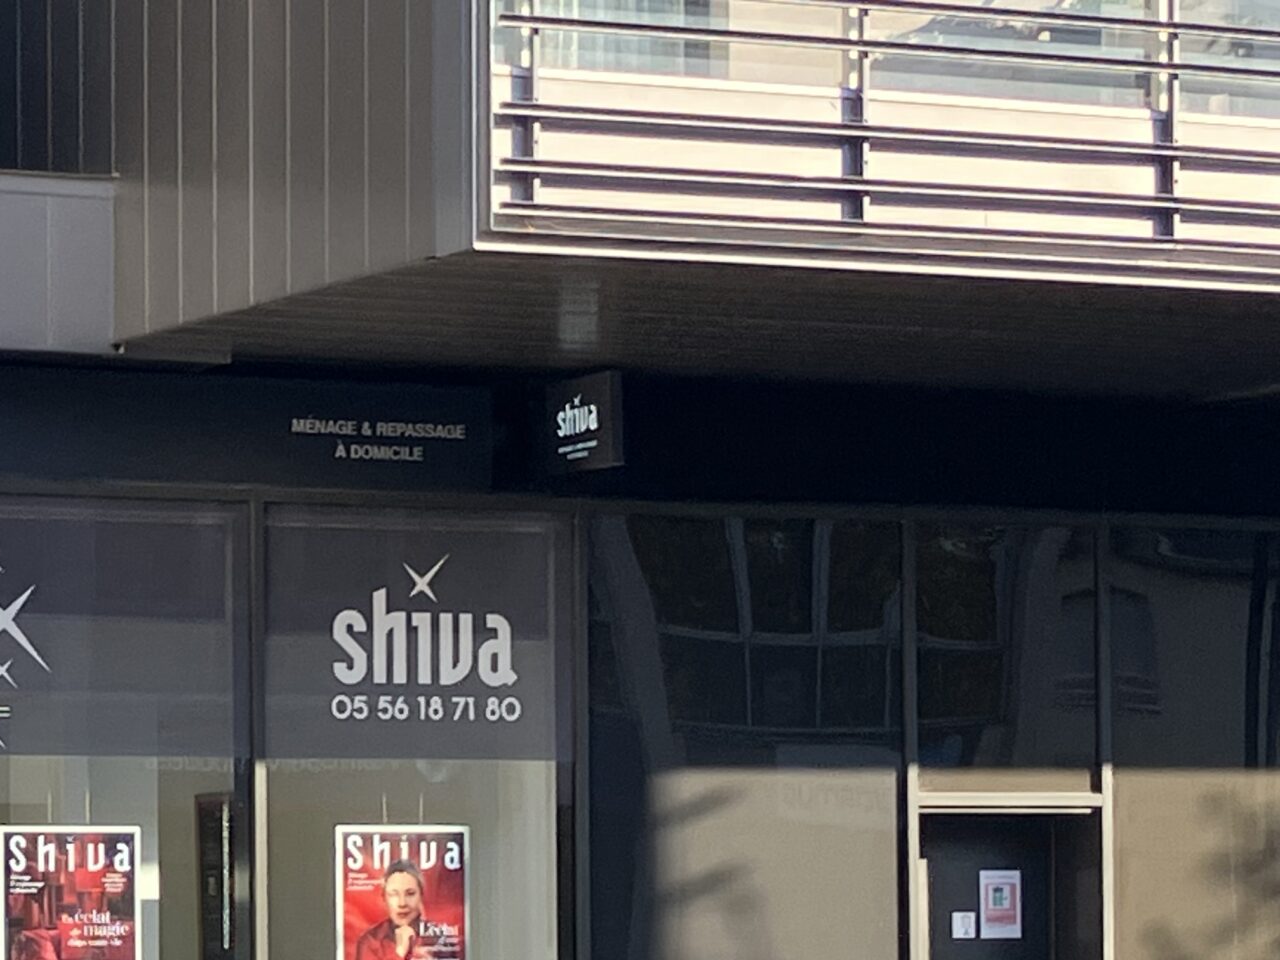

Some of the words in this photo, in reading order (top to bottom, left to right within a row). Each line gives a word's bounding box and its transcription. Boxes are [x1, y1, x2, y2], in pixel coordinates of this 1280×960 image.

[291, 415, 357, 435] MÉNAGE
[361, 421, 372, 436] &
[376, 422, 466, 439] REPASSAGE
[556, 394, 598, 437] shiva
[334, 440, 346, 459] À
[350, 445, 423, 461] DOMICILE
[332, 554, 518, 687] shiva
[331, 694, 369, 719] 05
[377, 696, 409, 720] 56
[417, 696, 444, 720] 18
[451, 697, 475, 721] 71
[485, 697, 521, 721] 80
[9, 834, 131, 872] Shiva
[347, 834, 461, 870] Shiva
[74, 908, 111, 924] éclat
[83, 920, 130, 938] magie
